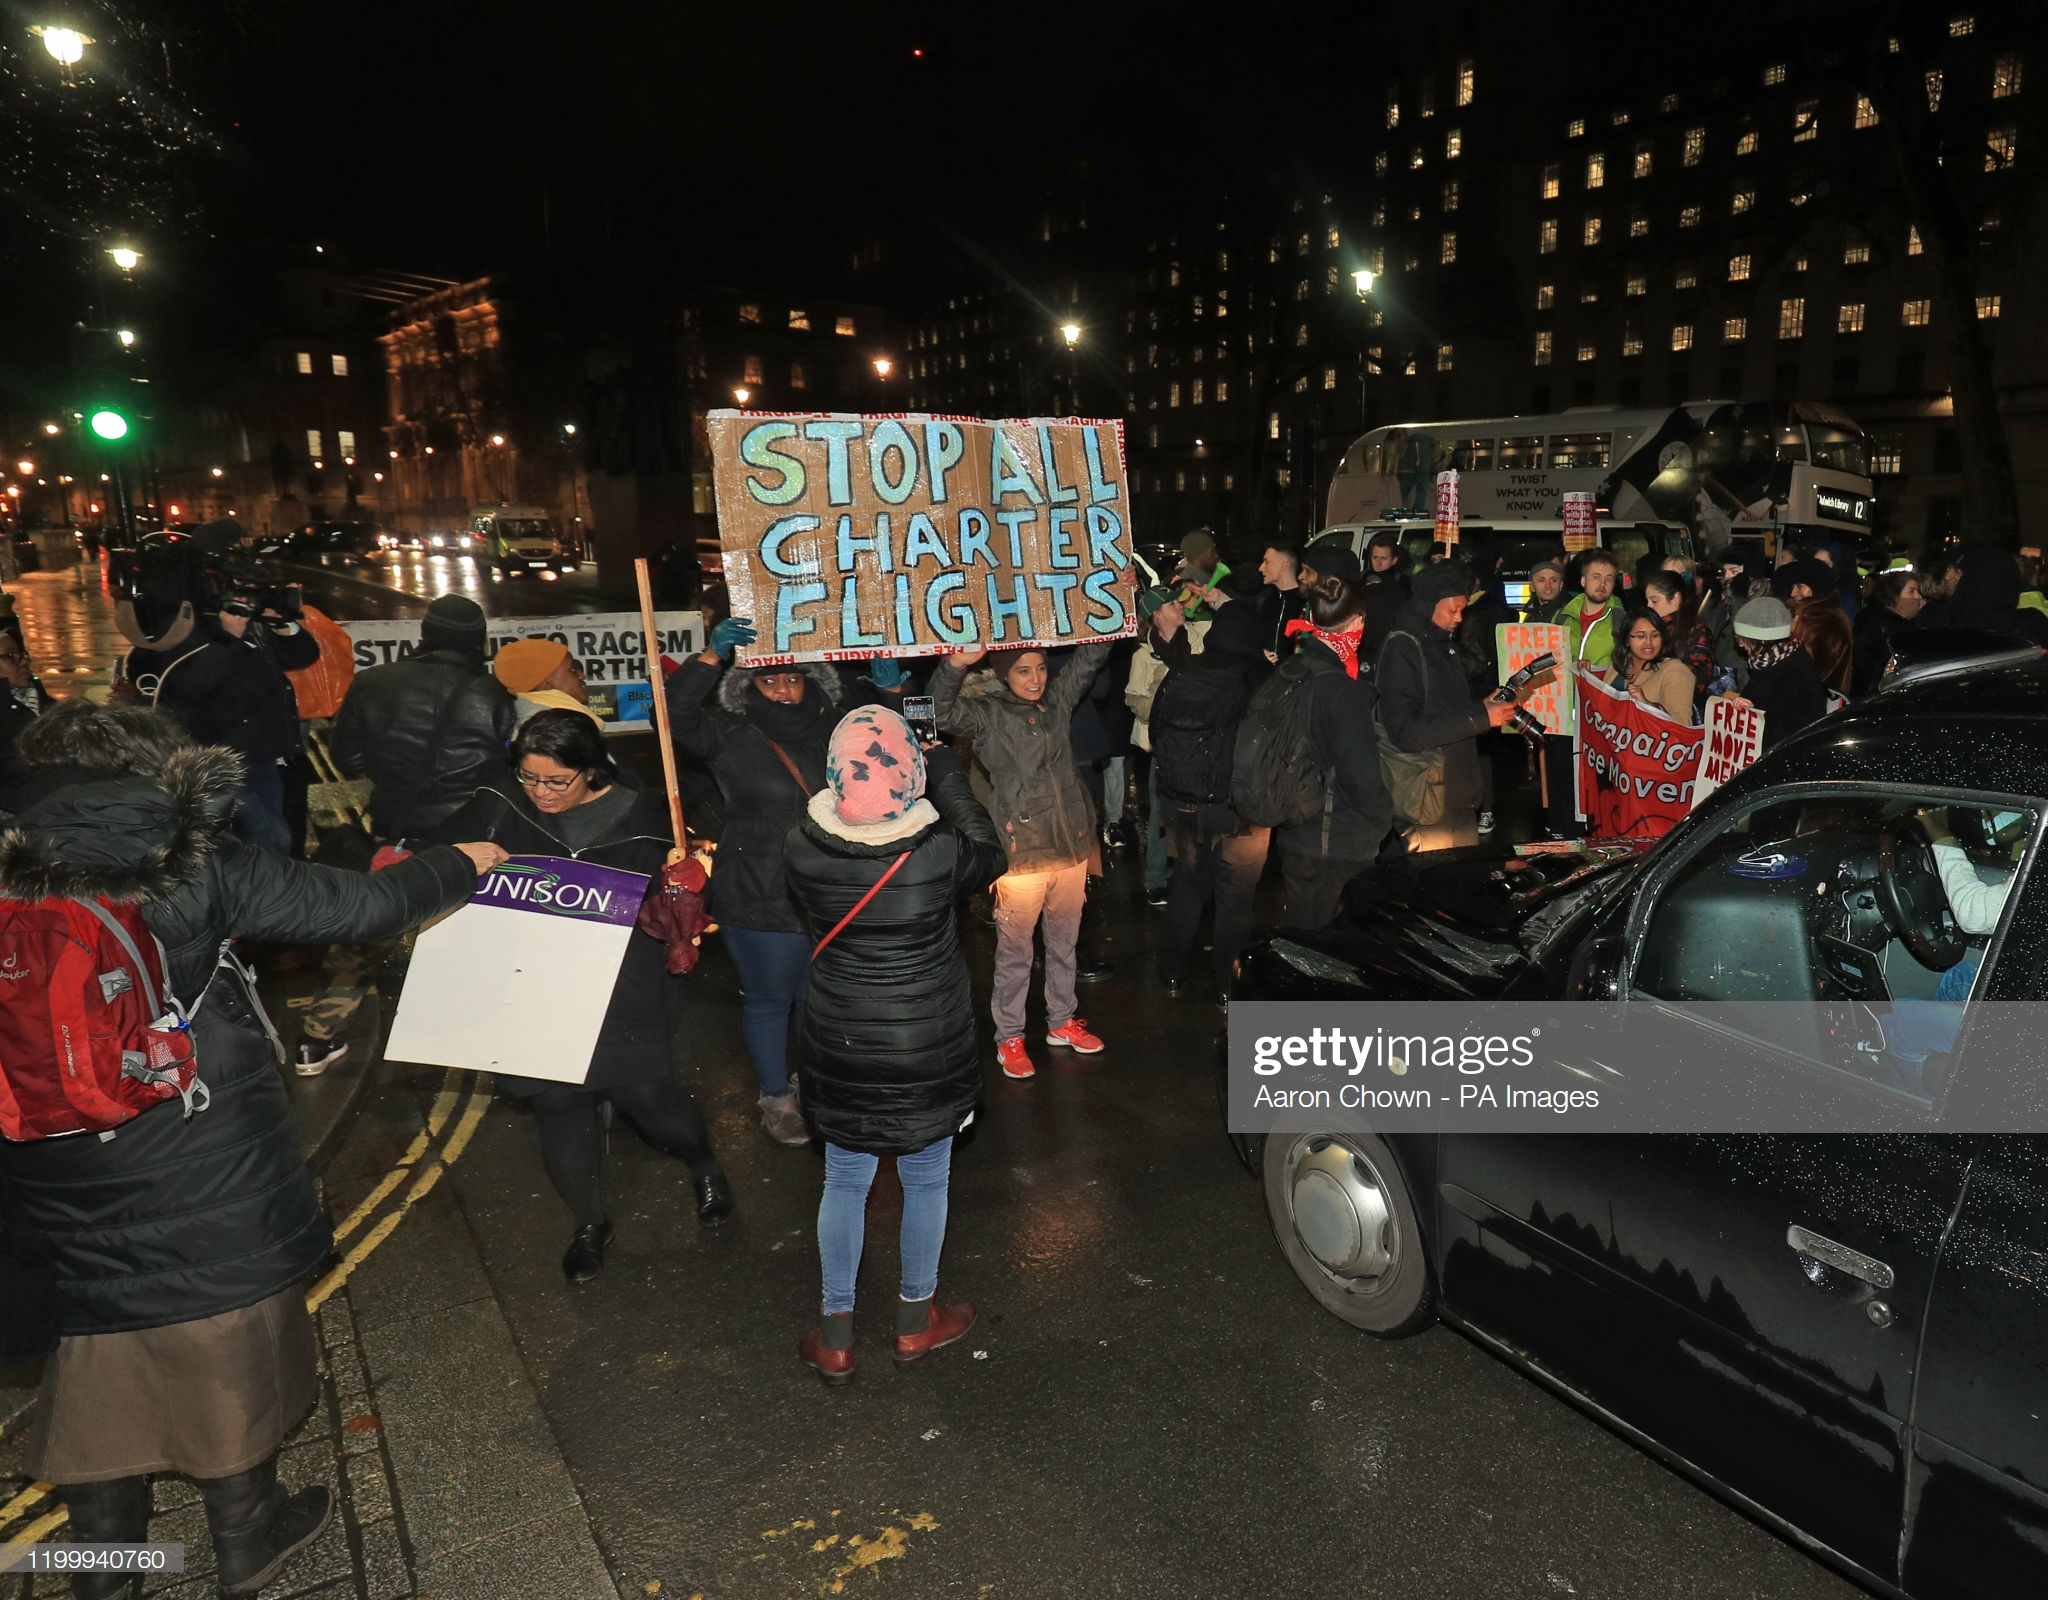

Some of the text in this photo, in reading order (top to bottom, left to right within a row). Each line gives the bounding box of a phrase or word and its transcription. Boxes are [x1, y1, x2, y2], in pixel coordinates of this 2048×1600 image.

[739, 420, 1121, 508] STOP ALL
[1510, 474, 1548, 484] TWIST
[1496, 487, 1560, 498] WHAT YOU
[1506, 501, 1545, 511] KNOW
[1855, 501, 1864, 519] 12
[758, 505, 1130, 580] CHARTER
[774, 568, 1128, 654] FLIGHTS
[576, 629, 692, 657] RACISM
[1506, 626, 1560, 650] FREE
[628, 690, 652, 701] Blac
[1713, 700, 1758, 740] FREE
[1710, 729, 1756, 769] MOVE
